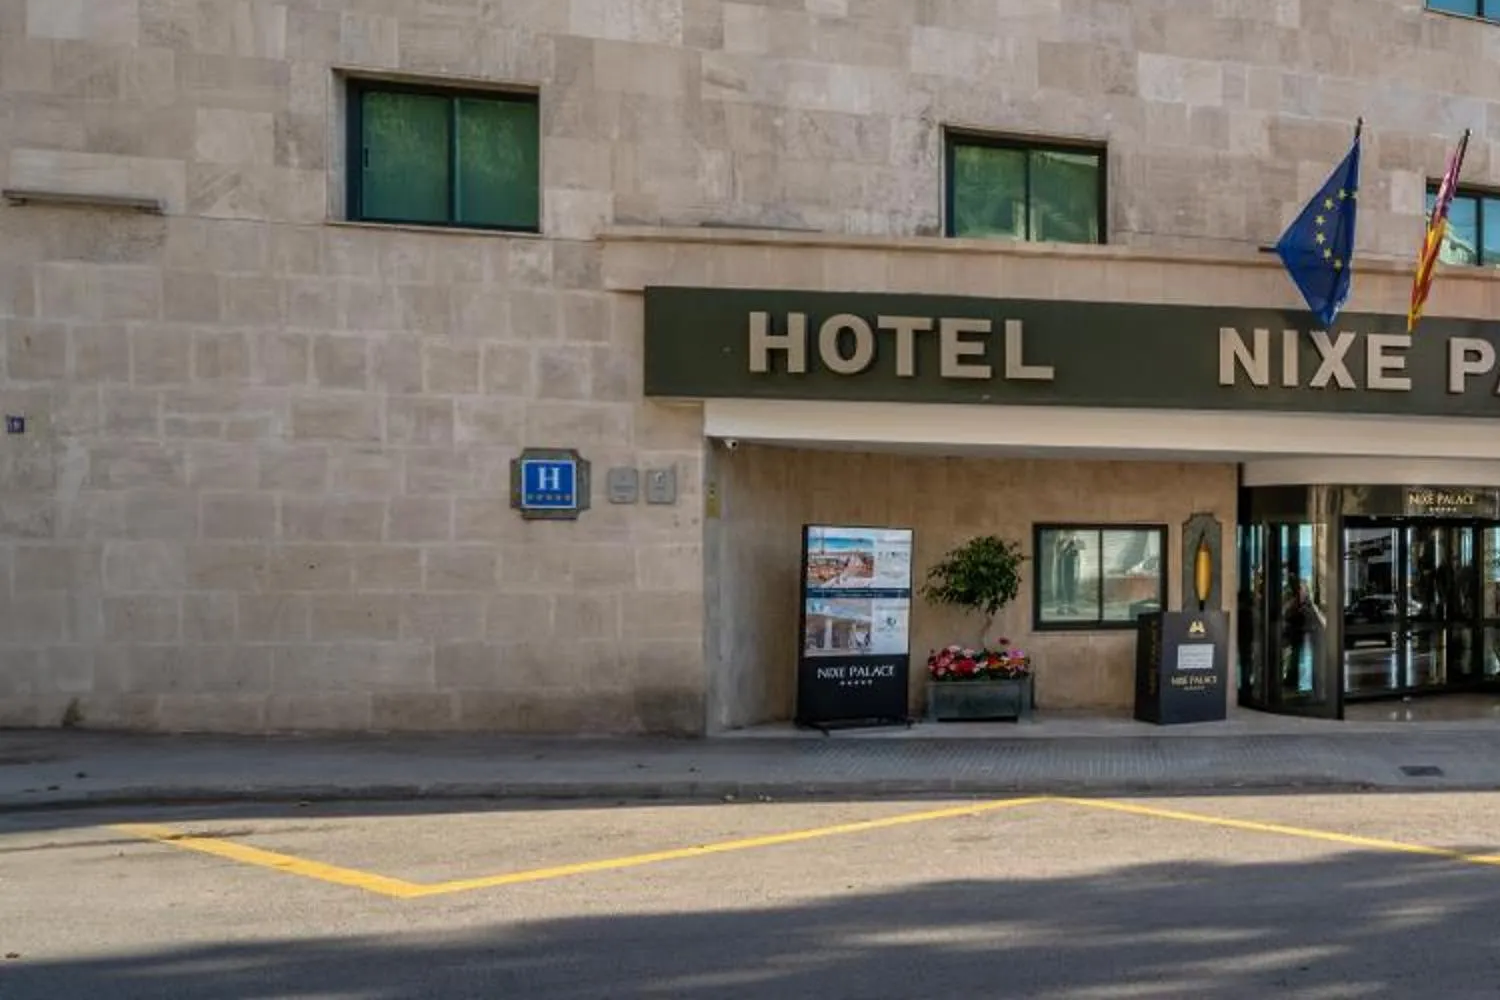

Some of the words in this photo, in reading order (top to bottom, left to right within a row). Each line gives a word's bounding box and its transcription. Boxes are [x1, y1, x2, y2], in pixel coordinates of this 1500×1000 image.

[749, 311, 1055, 380] HOTEL
[1218, 327, 1412, 391] NIXE
[536, 466, 561, 491] H
[1408, 493, 1434, 505] NIXE
[1437, 492, 1473, 505] PALACE
[817, 665, 846, 679] NIXE
[849, 664, 895, 678] PALACE
